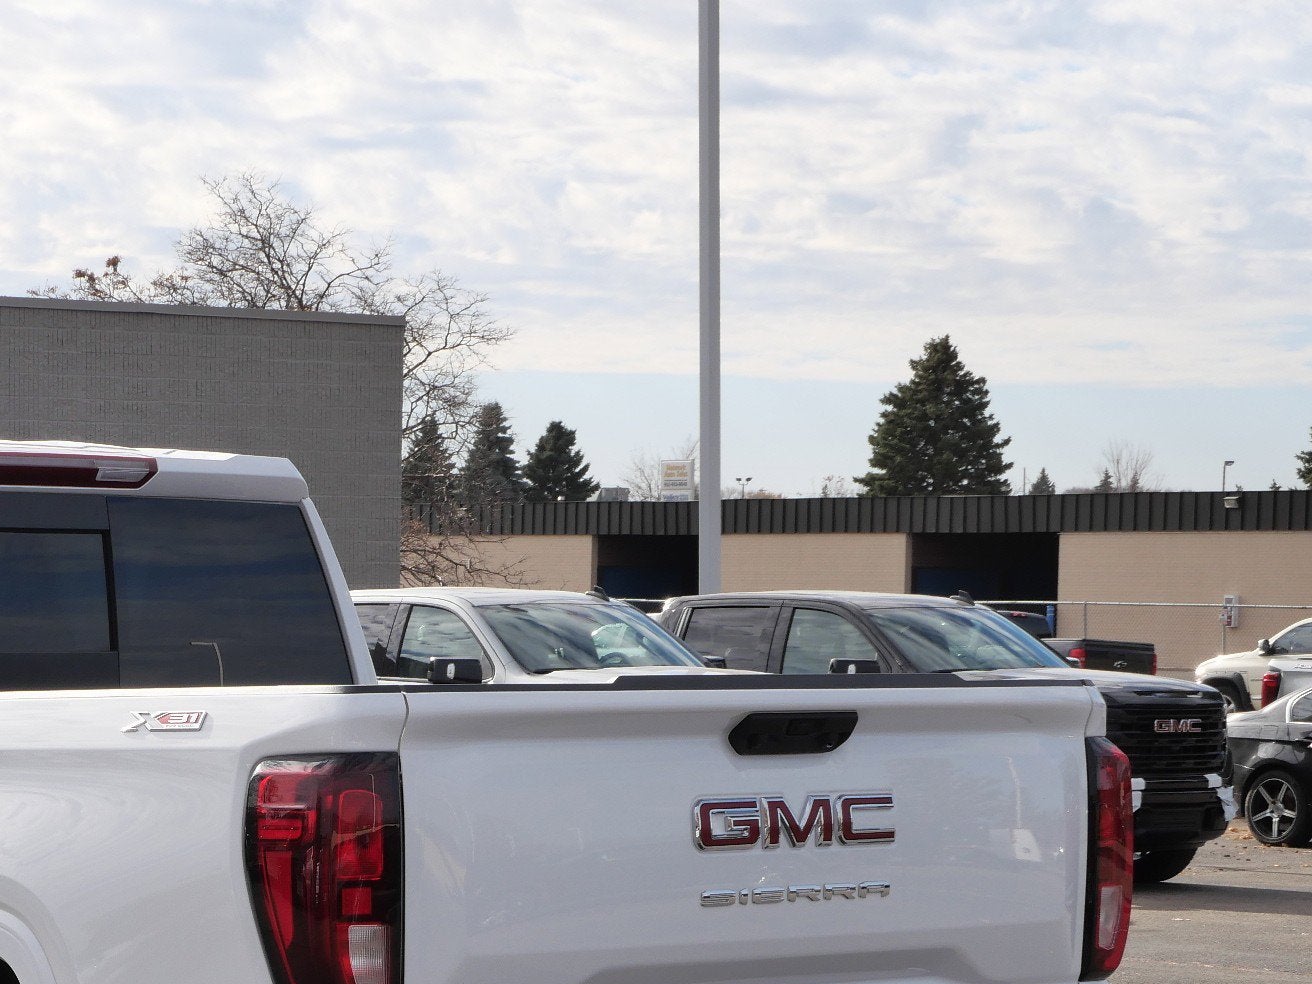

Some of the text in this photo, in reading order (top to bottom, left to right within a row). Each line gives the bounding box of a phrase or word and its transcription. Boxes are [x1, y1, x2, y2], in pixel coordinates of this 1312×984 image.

[1154, 719, 1201, 733] GMC
[693, 791, 896, 851] GMC
[700, 880, 891, 907] SIERRA
